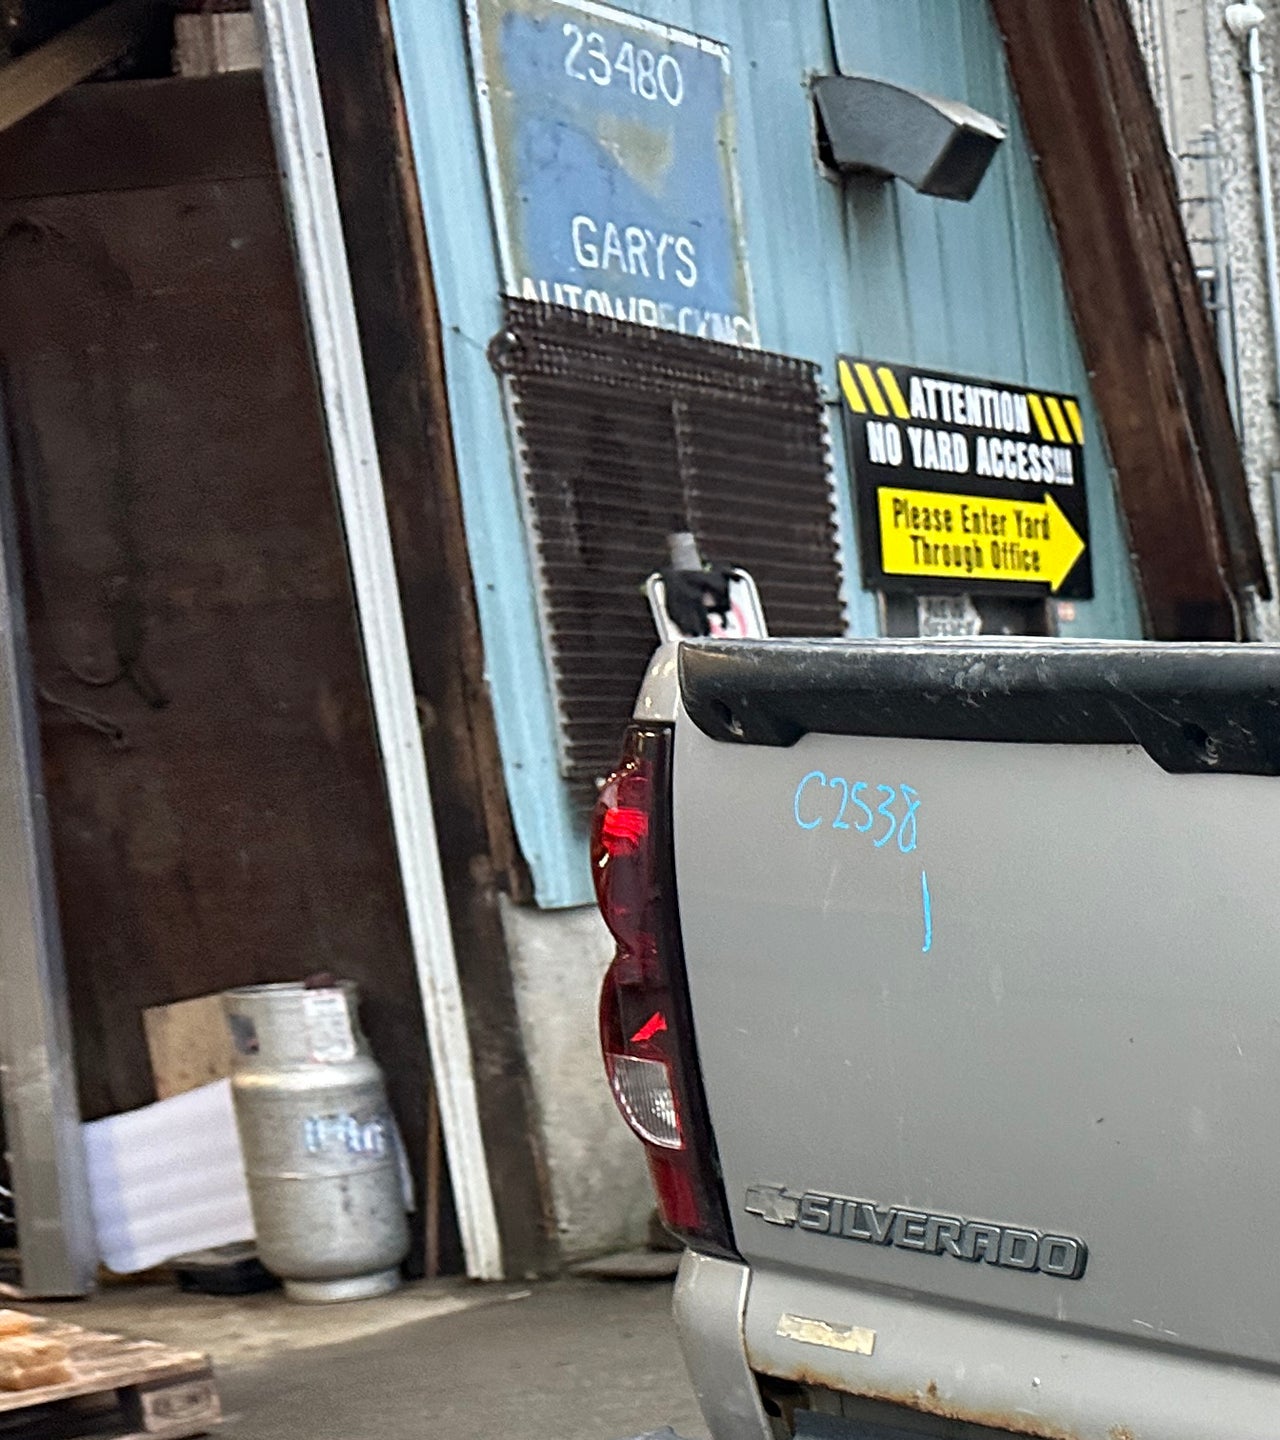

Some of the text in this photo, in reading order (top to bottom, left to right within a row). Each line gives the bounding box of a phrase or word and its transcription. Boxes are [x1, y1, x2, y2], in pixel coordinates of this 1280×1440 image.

[563, 22, 683, 106] 23480
[909, 376, 1031, 434] ATTENTION
[866, 420, 902, 466] NO
[907, 427, 969, 474] YARD
[892, 498, 1050, 540] Please Enter Yard
[910, 534, 1040, 573] Through Office
[794, 770, 921, 852] C2538
[800, 1191, 1088, 1279] SILVERADO
